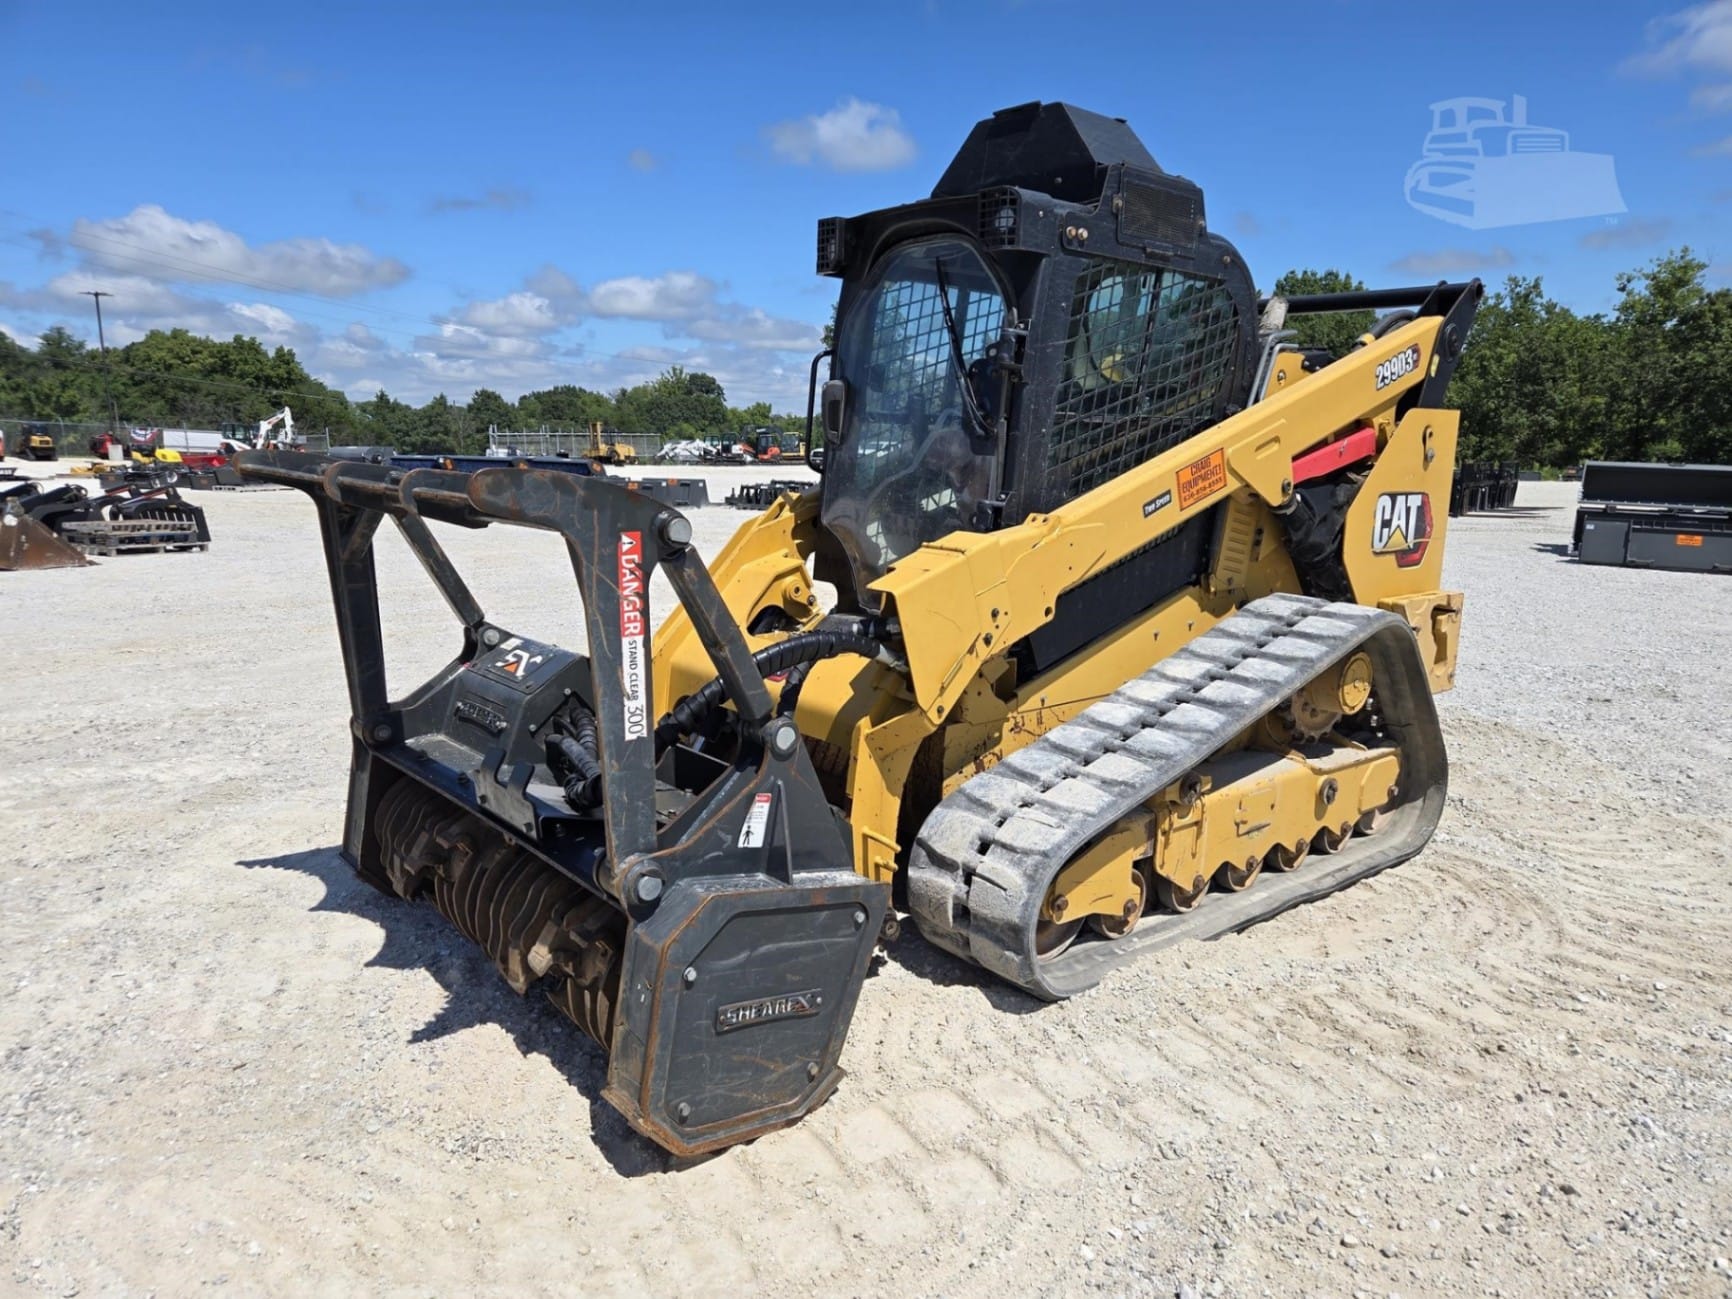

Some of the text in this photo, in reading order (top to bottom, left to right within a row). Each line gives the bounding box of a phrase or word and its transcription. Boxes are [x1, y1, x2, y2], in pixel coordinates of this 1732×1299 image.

[1376, 348, 1413, 390] 299D3
[1190, 456, 1211, 476] CRAIG
[1373, 494, 1422, 552] CAT
[621, 555, 641, 636] DANGER
[628, 639, 638, 670] STAND
[629, 672, 639, 701] CLEAR
